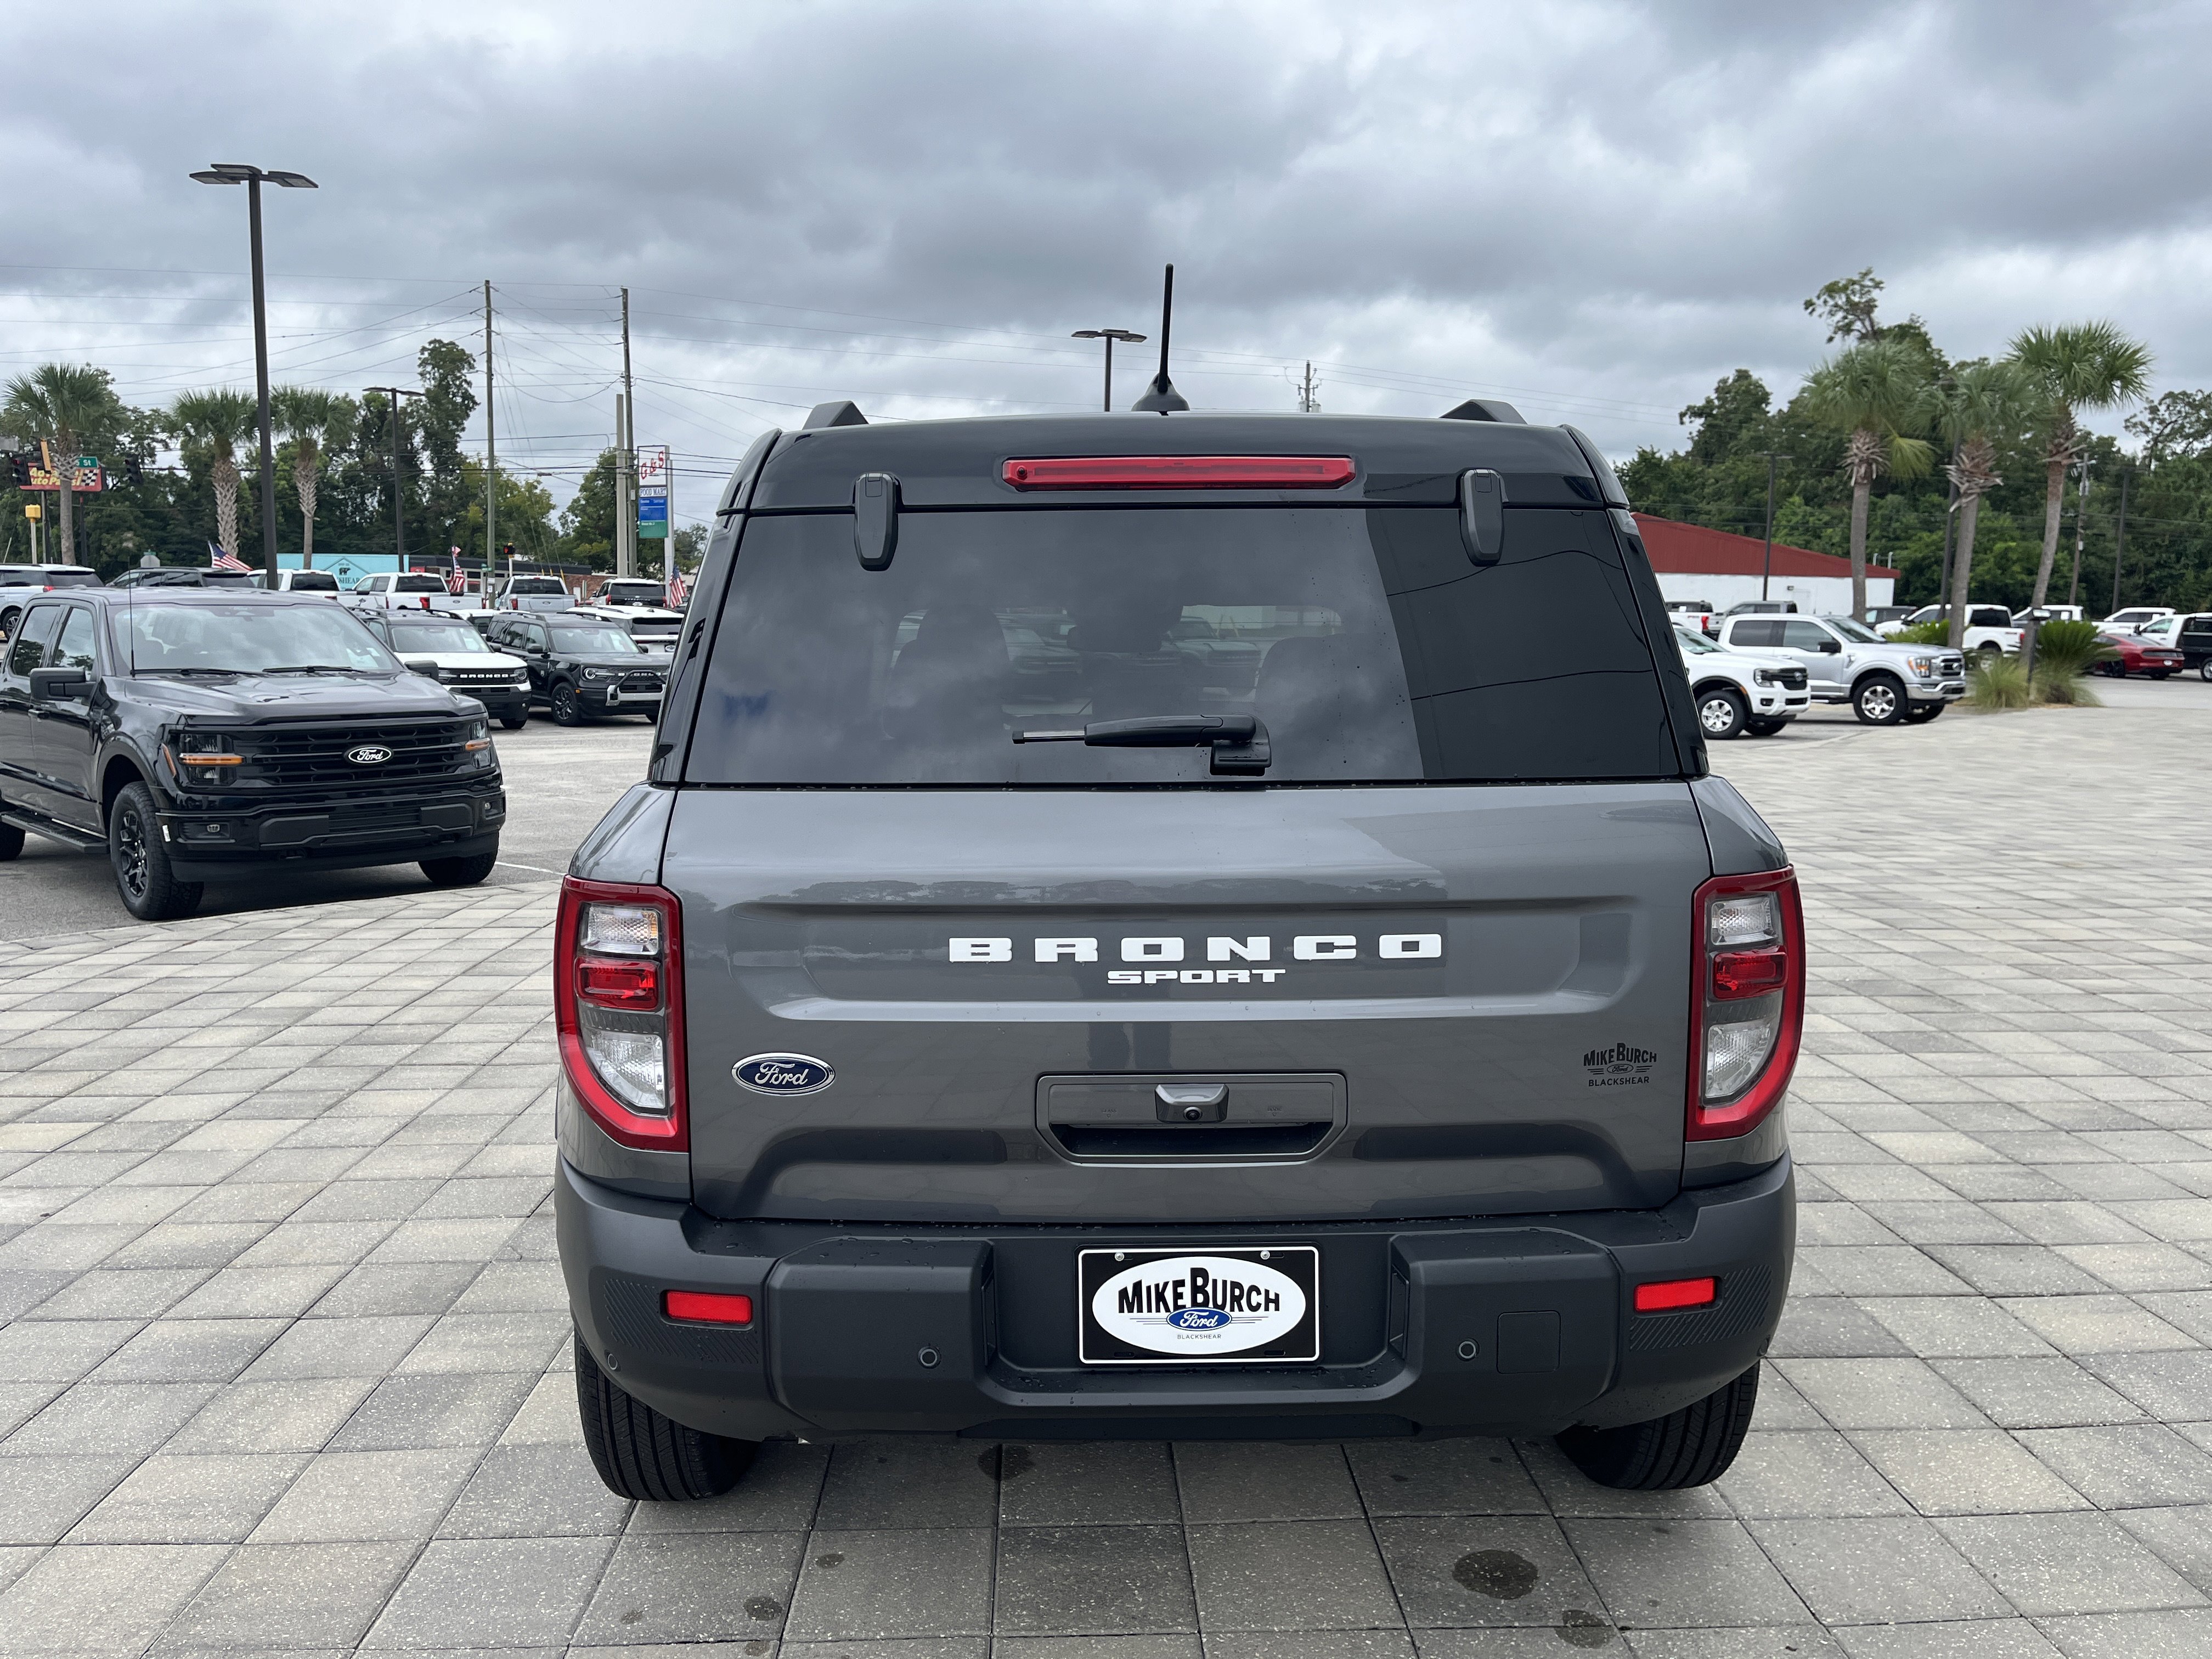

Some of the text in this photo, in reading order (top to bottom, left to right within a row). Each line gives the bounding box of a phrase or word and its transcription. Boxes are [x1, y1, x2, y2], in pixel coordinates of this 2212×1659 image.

[658, 450, 664, 468] S
[31, 477, 48, 485] uto
[357, 749, 383, 761] Ford
[949, 933, 1442, 963] BRONCO
[1107, 968, 1286, 984] SPORT
[1583, 1042, 1657, 1066] MIKE BURCH
[754, 1062, 809, 1085] Ford
[1588, 1076, 1650, 1087] BLACKSHEAR
[1118, 1267, 1280, 1313] MIKE BURCH
[1180, 1311, 1219, 1327] Ford
